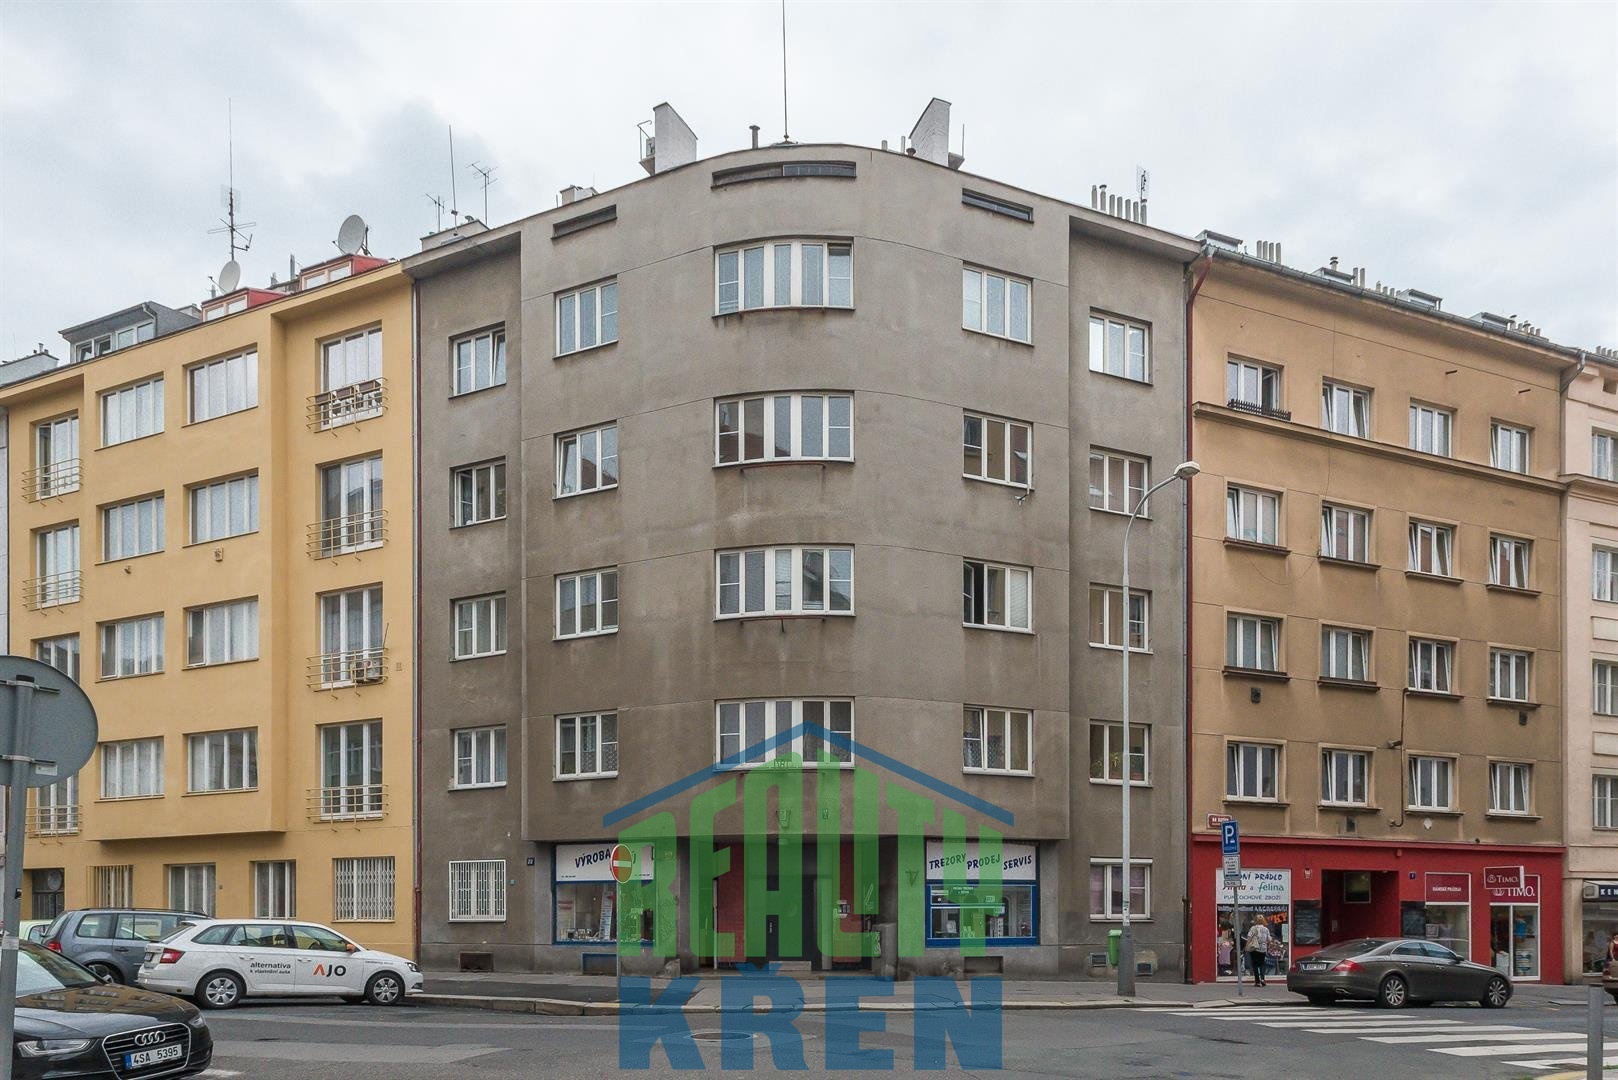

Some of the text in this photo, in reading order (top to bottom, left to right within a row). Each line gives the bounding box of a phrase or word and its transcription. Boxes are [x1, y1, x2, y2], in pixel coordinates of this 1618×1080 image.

[575, 848, 612, 868] VÝROBA
[929, 853, 1032, 870] TREZORY PRODEJ SERVIS
[1255, 871, 1283, 881] PRÁDLO
[1257, 881, 1285, 893] felina
[134, 1046, 178, 1065] 4SA 5395
